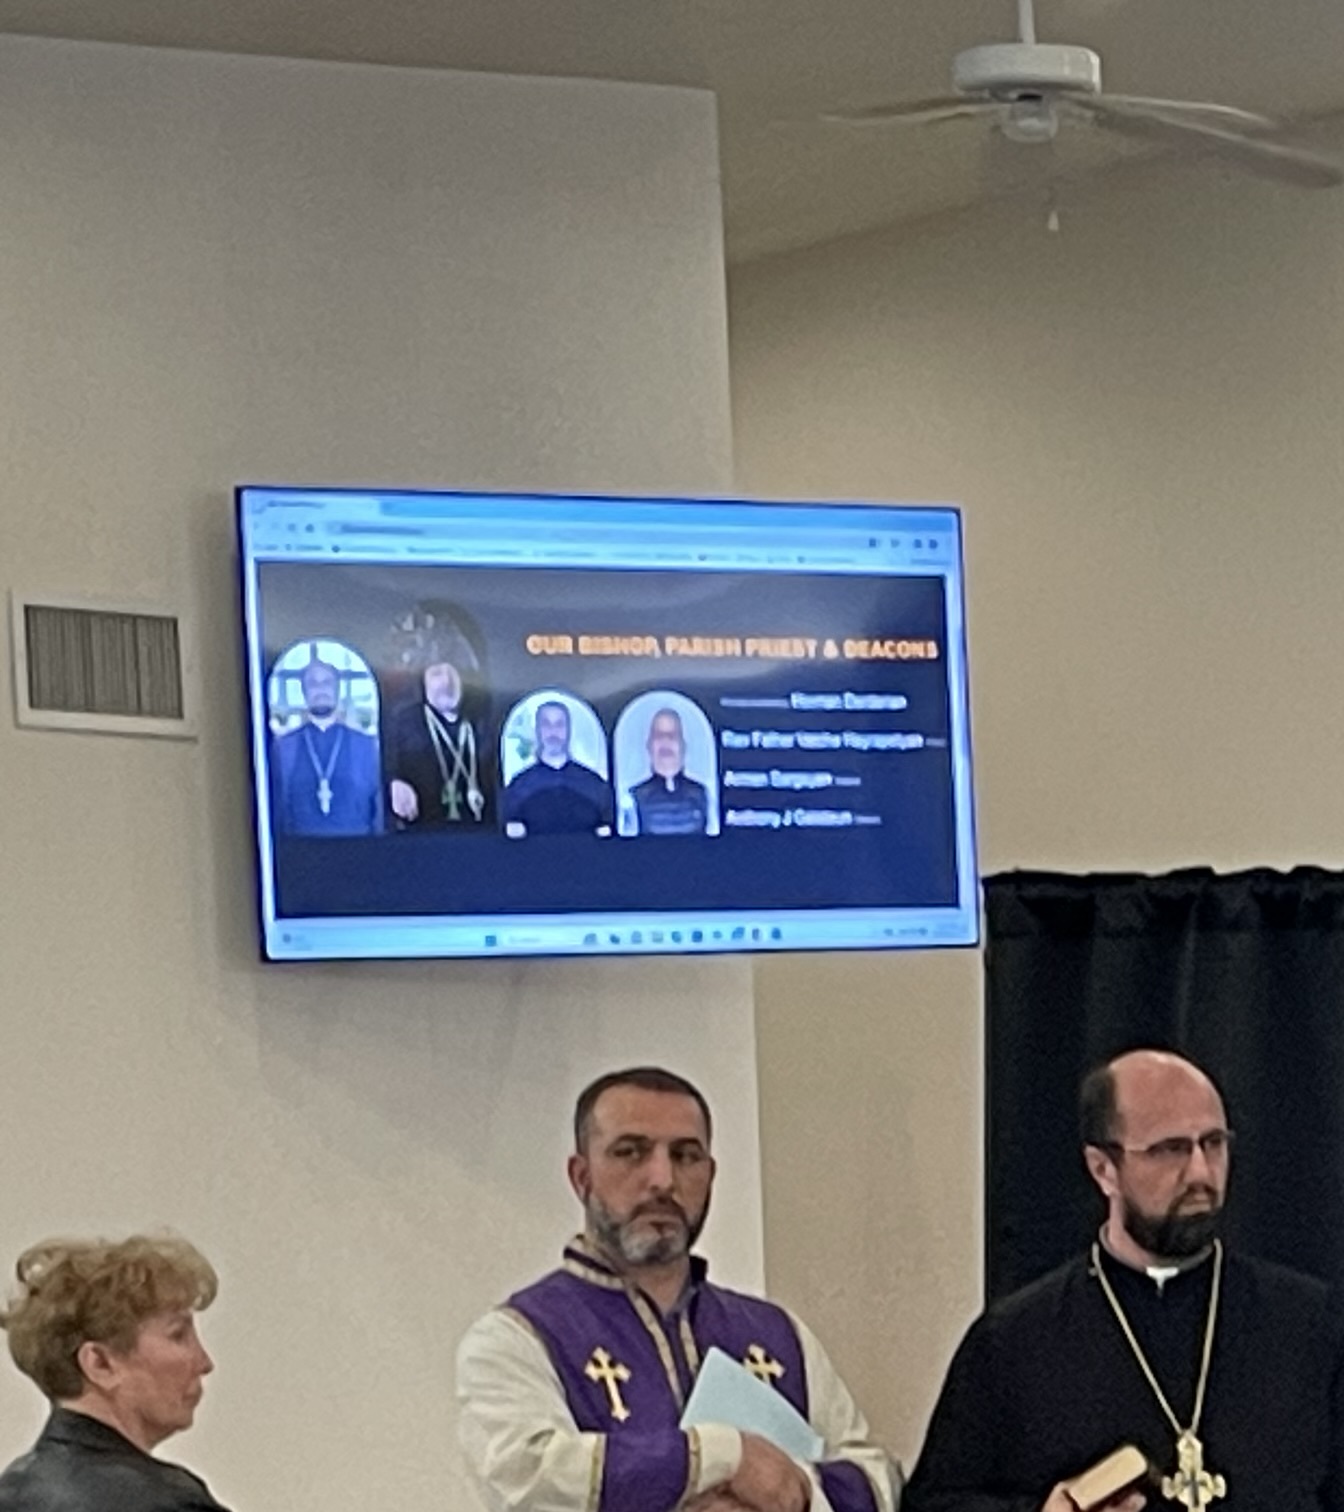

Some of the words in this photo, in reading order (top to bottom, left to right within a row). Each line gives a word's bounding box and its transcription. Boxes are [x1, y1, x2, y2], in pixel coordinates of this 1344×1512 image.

[526, 634, 573, 655] OUR
[578, 635, 661, 659] BISHOP,
[665, 636, 741, 656] PARISH
[745, 637, 817, 658] PRIEST
[823, 639, 838, 658] &
[843, 640, 938, 659] DEACONS
